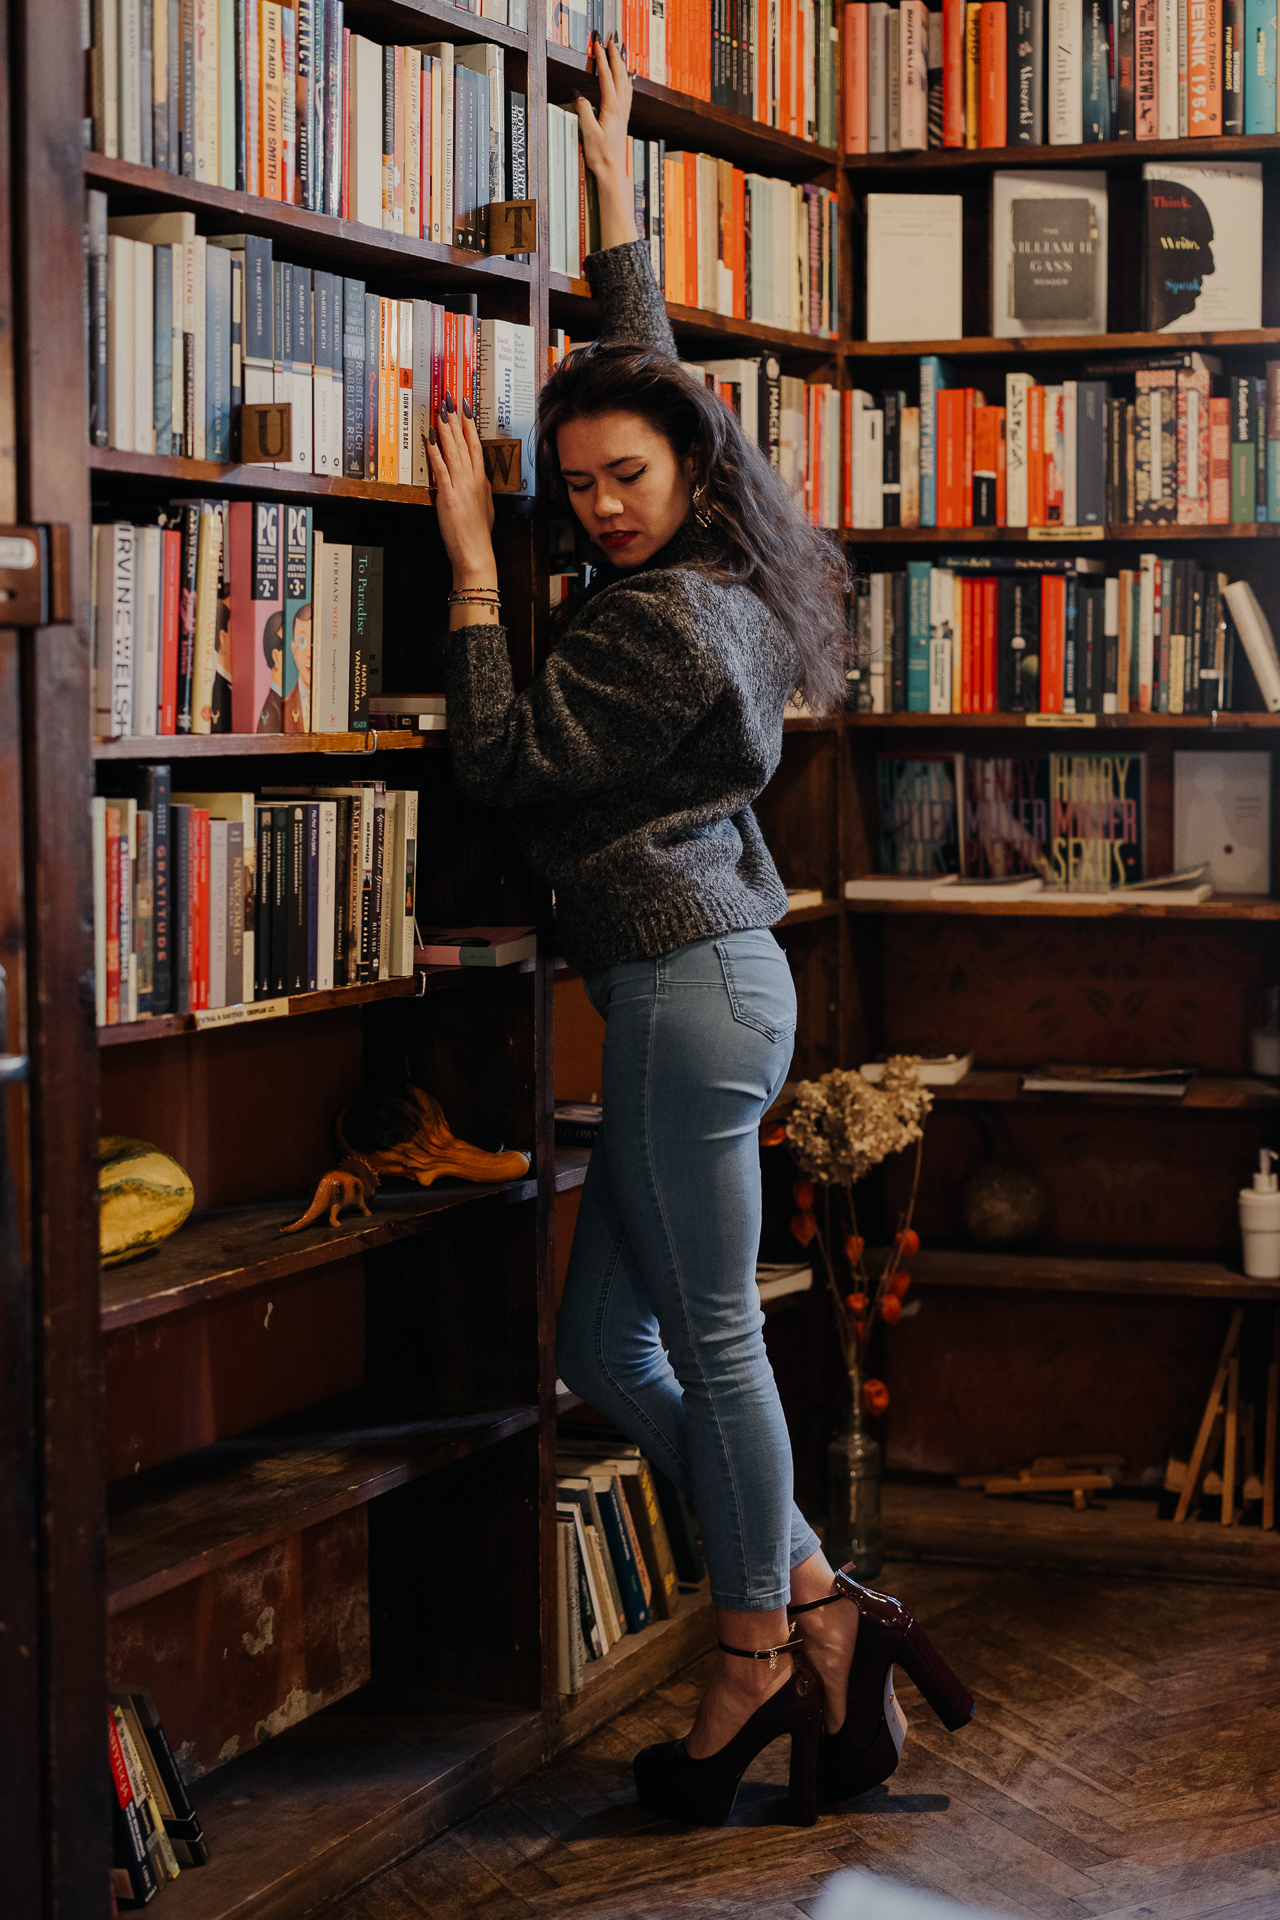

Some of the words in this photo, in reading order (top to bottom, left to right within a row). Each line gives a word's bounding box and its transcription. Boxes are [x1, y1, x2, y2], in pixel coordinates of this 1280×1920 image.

[268, 10, 277, 32] THE
[268, 38, 277, 79] FRAUD
[284, 35, 295, 80] ZADIE
[970, 20, 980, 65] POTOP
[1056, 43, 1072, 125] Znikanie
[1208, 42, 1216, 91] TYRMAND
[268, 97, 277, 133] ZADIE
[284, 88, 295, 132] SMITH
[1019, 65, 1034, 124] Akuszerki
[1191, 75, 1207, 124] 1954
[516, 107, 526, 152] DONNA
[268, 138, 277, 180] SMITH
[300, 126, 308, 180] SORRENTINO
[444, 178, 452, 210] Styron
[516, 155, 526, 200] TARTT
[506, 206, 532, 249] T
[1030, 260, 1072, 273] GASS
[299, 314, 304, 326] AT
[321, 320, 326, 328] IS
[346, 316, 364, 324] RABBIT
[346, 325, 364, 335] NOVELS
[497, 336, 508, 344] David
[347, 344, 362, 358] TWO
[346, 360, 354, 406] RABBIT
[355, 362, 363, 403] RABBIT
[504, 368, 512, 425] Infinite
[1238, 388, 1248, 416] Captive
[256, 408, 286, 458] U
[346, 410, 354, 422] AT
[355, 408, 363, 419] IS
[368, 402, 376, 436] Learning
[498, 396, 506, 430] Jest
[769, 387, 780, 442] MARCEL
[1238, 418, 1248, 440] Spirit
[346, 426, 354, 457] REST
[355, 422, 363, 450] RICH
[116, 525, 131, 625] IRVINE
[187, 535, 196, 578] WILSON
[257, 564, 277, 573] JEEVES
[287, 564, 306, 572] JEEVES
[357, 555, 368, 574] To
[262, 580, 270, 598] 2
[292, 579, 301, 597] 3
[357, 578, 368, 636] Paradise
[116, 636, 130, 736] WELSH
[354, 650, 362, 712] YANAGIHARA
[1055, 757, 1130, 803] HENRY
[156, 845, 166, 962] GRATITUDE
[233, 856, 242, 956] NEWCOMERS
[375, 870, 384, 912] Afternoon
[120, 1739, 134, 1769] FORSYTE
